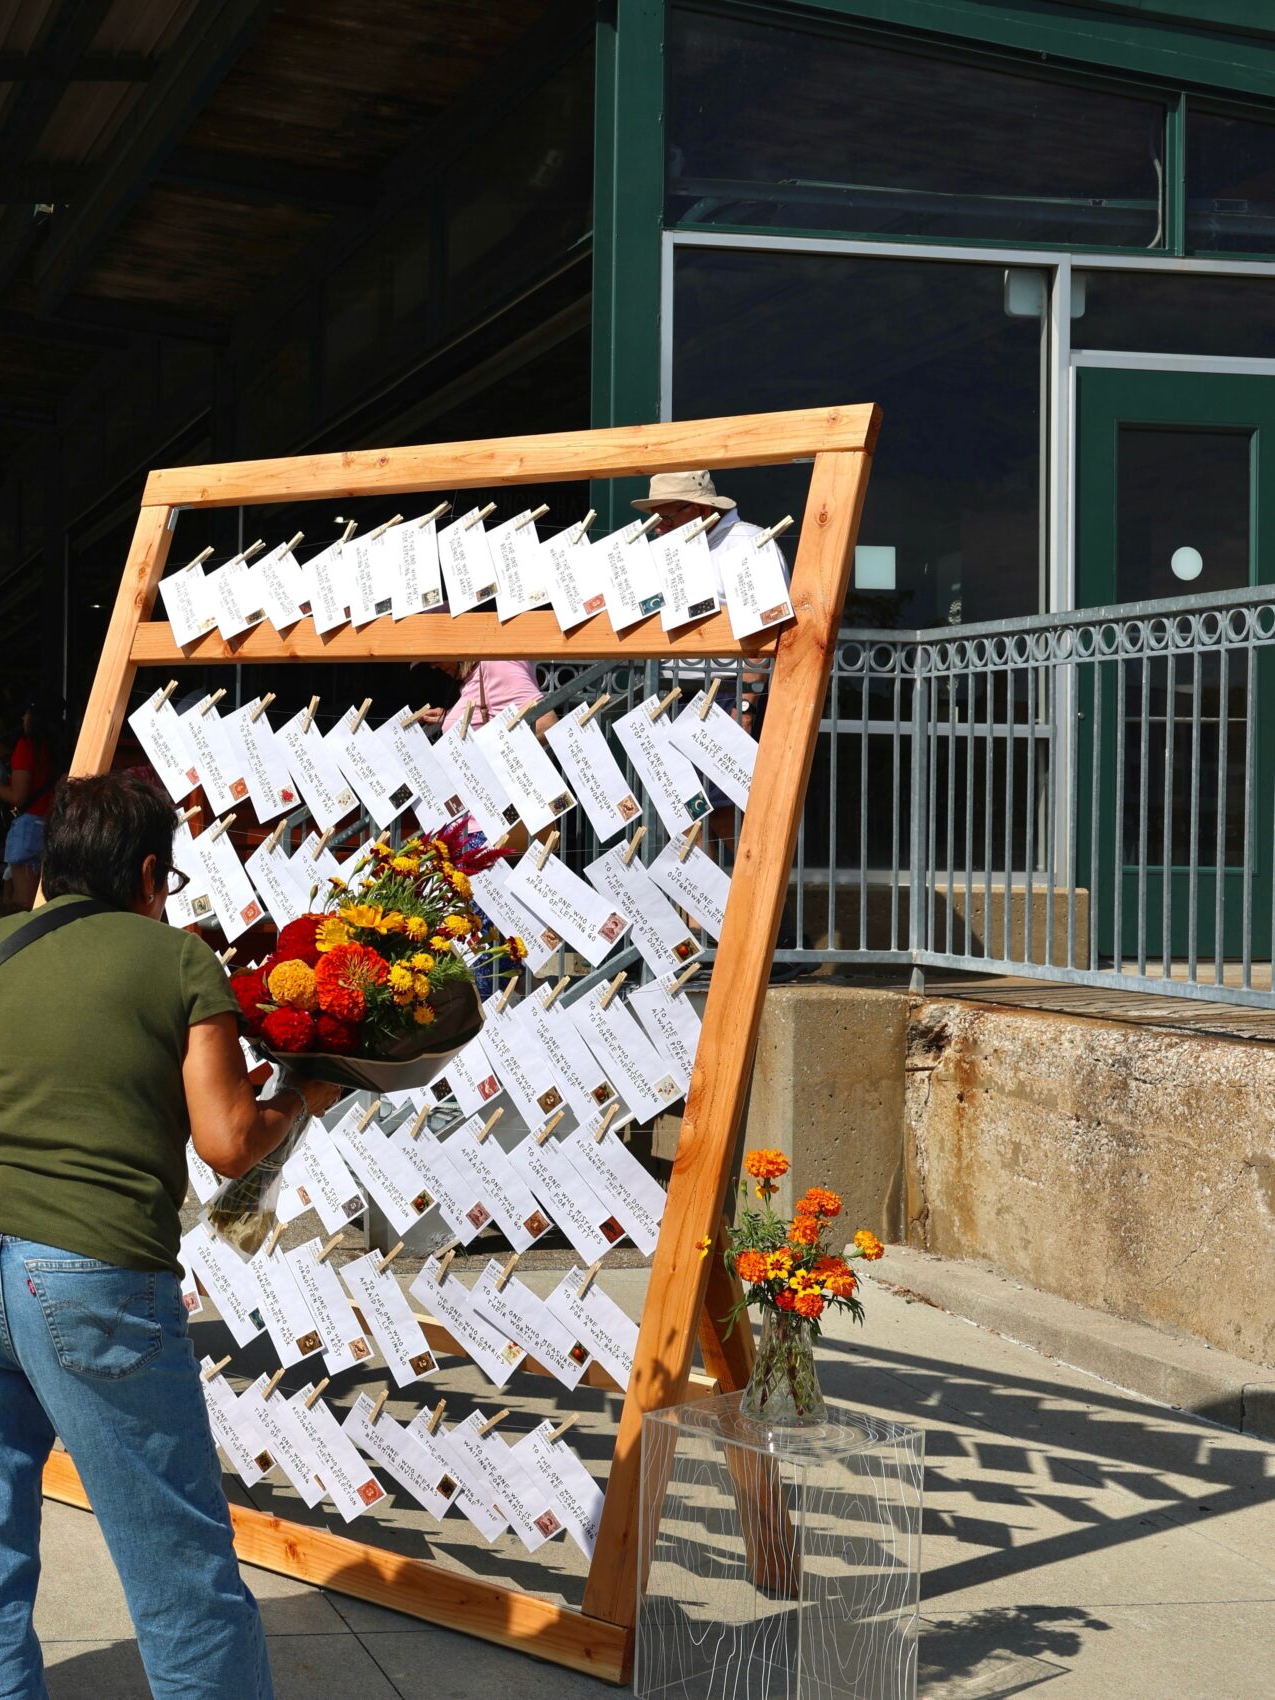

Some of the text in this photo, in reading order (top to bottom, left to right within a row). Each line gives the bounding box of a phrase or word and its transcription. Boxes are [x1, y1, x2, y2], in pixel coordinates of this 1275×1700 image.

[497, 729, 547, 809] TO THE ONE WHO HIDES
[500, 749, 531, 798] BEHIND HUMOR
[567, 727, 617, 819] TO THE ONE WHO DOUBTS
[568, 744, 604, 810] THEIR OWN WORTH
[629, 721, 683, 819] STOP REPLAYING THE PAST
[638, 722, 687, 810] TO THE ONE WHO CAN'T
[525, 876, 597, 942] AFRAID OF LETTING GO
[535, 874, 597, 932] TO THE ONE WHO IS
[604, 861, 676, 965] TO THE ONE WHO MEASURES
[604, 875, 663, 960] THEIR WORTH BY DOING
[485, 1029, 532, 1103] ALWAYS PERFORMING
[492, 1026, 537, 1097] TO THE ONE WHO'S
[531, 1006, 592, 1104] TO THE ONE WHO CARRIES
[536, 1028, 577, 1087] UNSPOKEN GRIEF
[527, 1146, 603, 1245] TO THE ONE WHO MISTAKES
[528, 1161, 591, 1239] CONTROL FOR SAFETY
[576, 1139, 656, 1238] RECOGNIZE THEIR REFLECTION
[586, 1142, 655, 1225] TO THE ONE WHO DOESN'T
[197, 1246, 245, 1323] TERRIFIED OF CHANGE
[204, 1246, 248, 1316] TO THE ONE WHO IS
[251, 1261, 291, 1347] OUTGROWN THEIR MASK
[257, 1259, 296, 1342] TO THE ONE WHO HAS
[426, 1280, 505, 1365] TO THE ONE WHO CARRIES
[437, 1300, 487, 1352] UNSPOKEN GRIEF
[254, 1407, 310, 1484] TIRED OF PRETENDING
[262, 1408, 311, 1475] TO THE ONE WHO'S
[463, 1440, 534, 1532] WAITING FOR PERMISSION
[475, 1444, 532, 1520] TO THE ONE WHO IS
